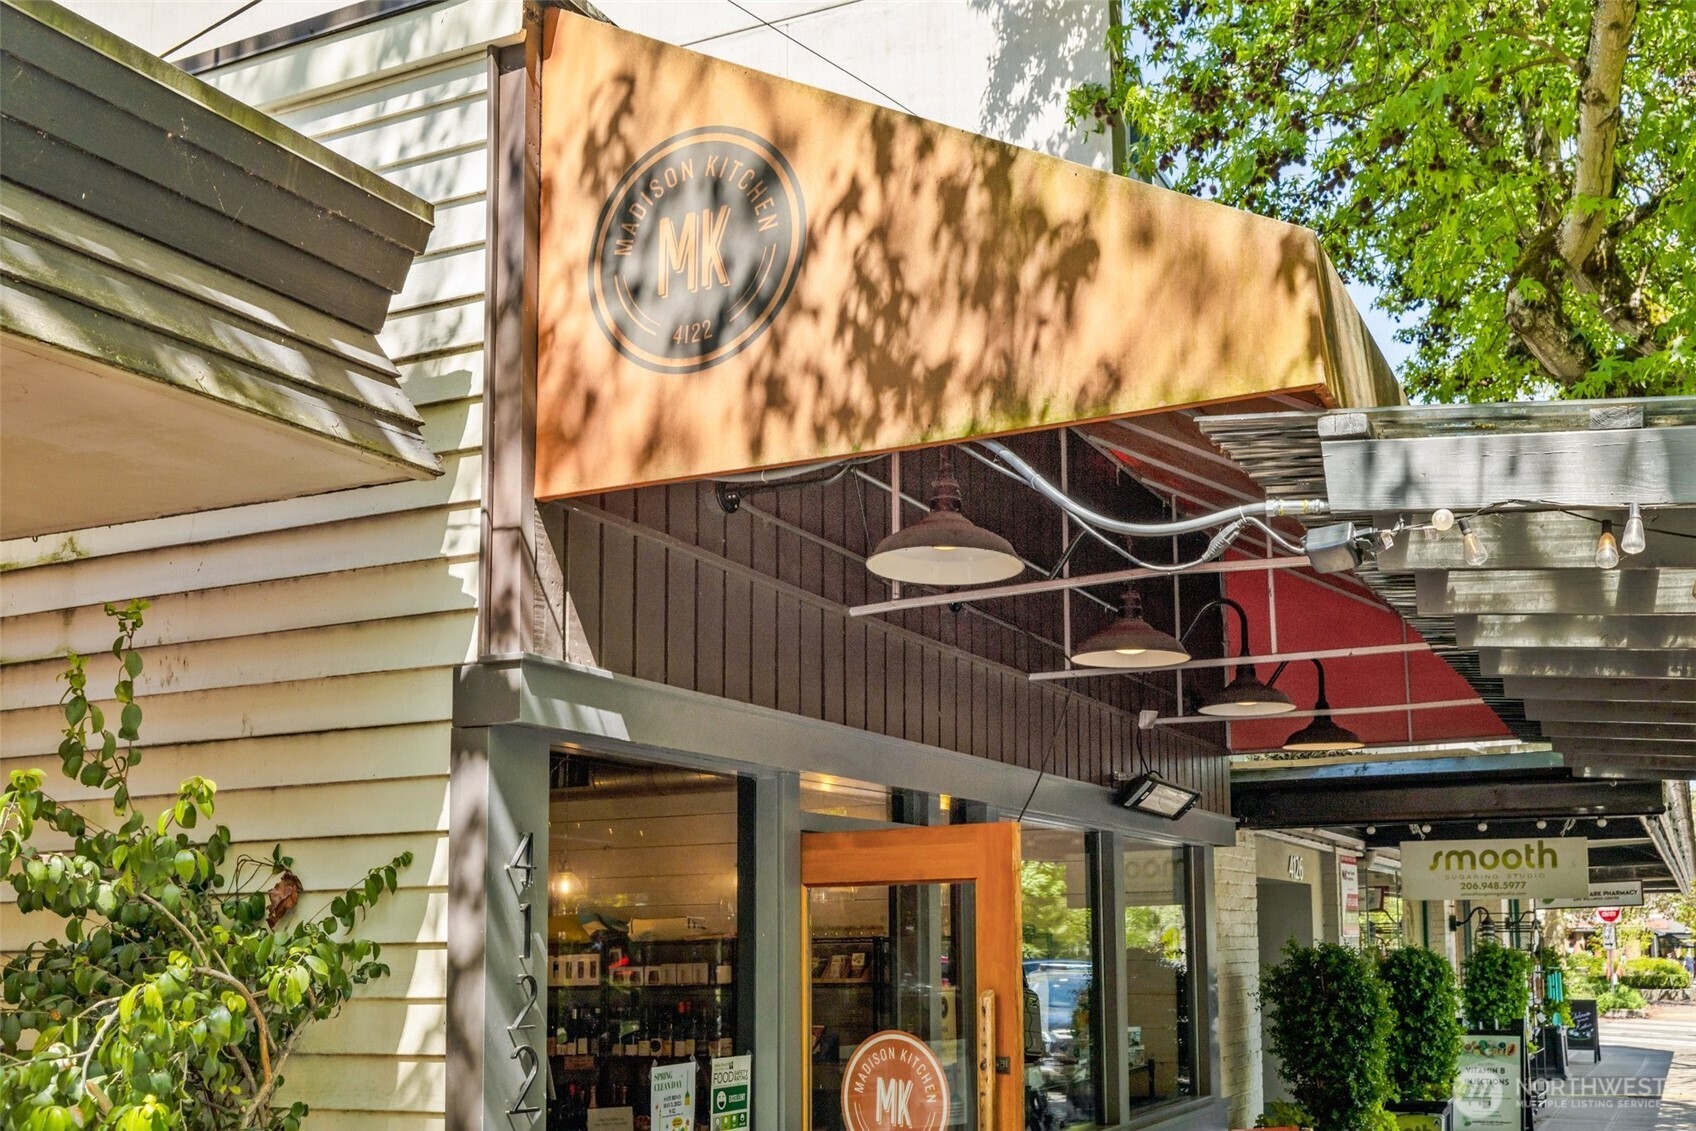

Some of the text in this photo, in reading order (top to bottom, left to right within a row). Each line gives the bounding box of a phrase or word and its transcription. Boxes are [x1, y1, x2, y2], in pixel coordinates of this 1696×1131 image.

[614, 155, 778, 256] MADISON KITCHEN
[658, 204, 731, 299] MK
[673, 320, 713, 344] 4122
[1429, 840, 1557, 871] smooth
[1460, 881, 1527, 890] 206.948.5977
[1603, 889, 1638, 897] PHARMACY
[654, 1071, 673, 1081] SPRING
[713, 1071, 734, 1085] FOOD
[854, 1046, 937, 1103] MADISON KITCHEN
[1464, 1078, 1510, 1086] INJECTIONS
[876, 1077, 914, 1129] MK
